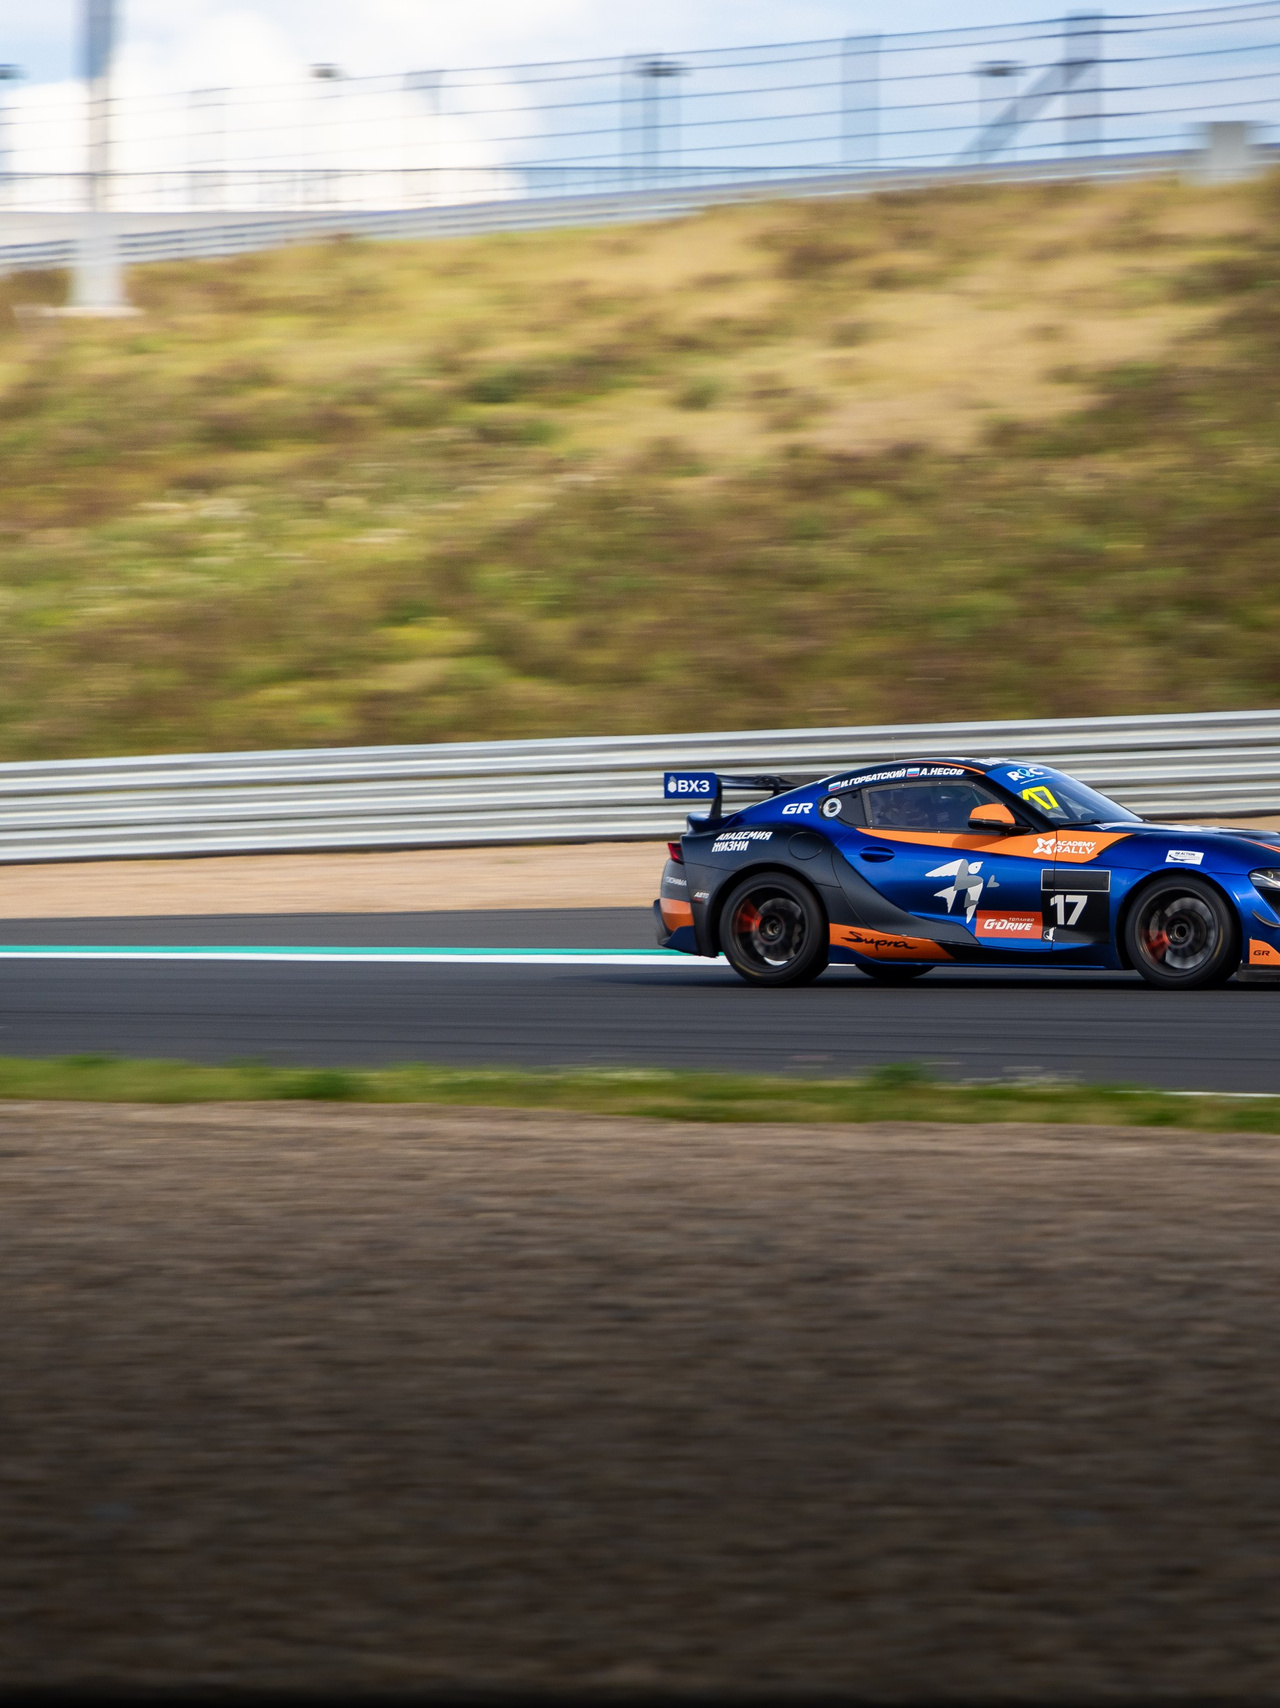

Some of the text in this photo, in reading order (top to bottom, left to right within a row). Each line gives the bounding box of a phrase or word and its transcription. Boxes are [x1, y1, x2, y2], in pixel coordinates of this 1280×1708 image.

[1022, 785, 1059, 810] 17
[782, 802, 814, 815] GR
[715, 831, 773, 841] АКАДЕМИЯ
[711, 841, 750, 852] ЖИЗНИ
[1053, 845, 1095, 854] RALLY
[1050, 894, 1088, 925] 17
[841, 930, 918, 951] Supra
